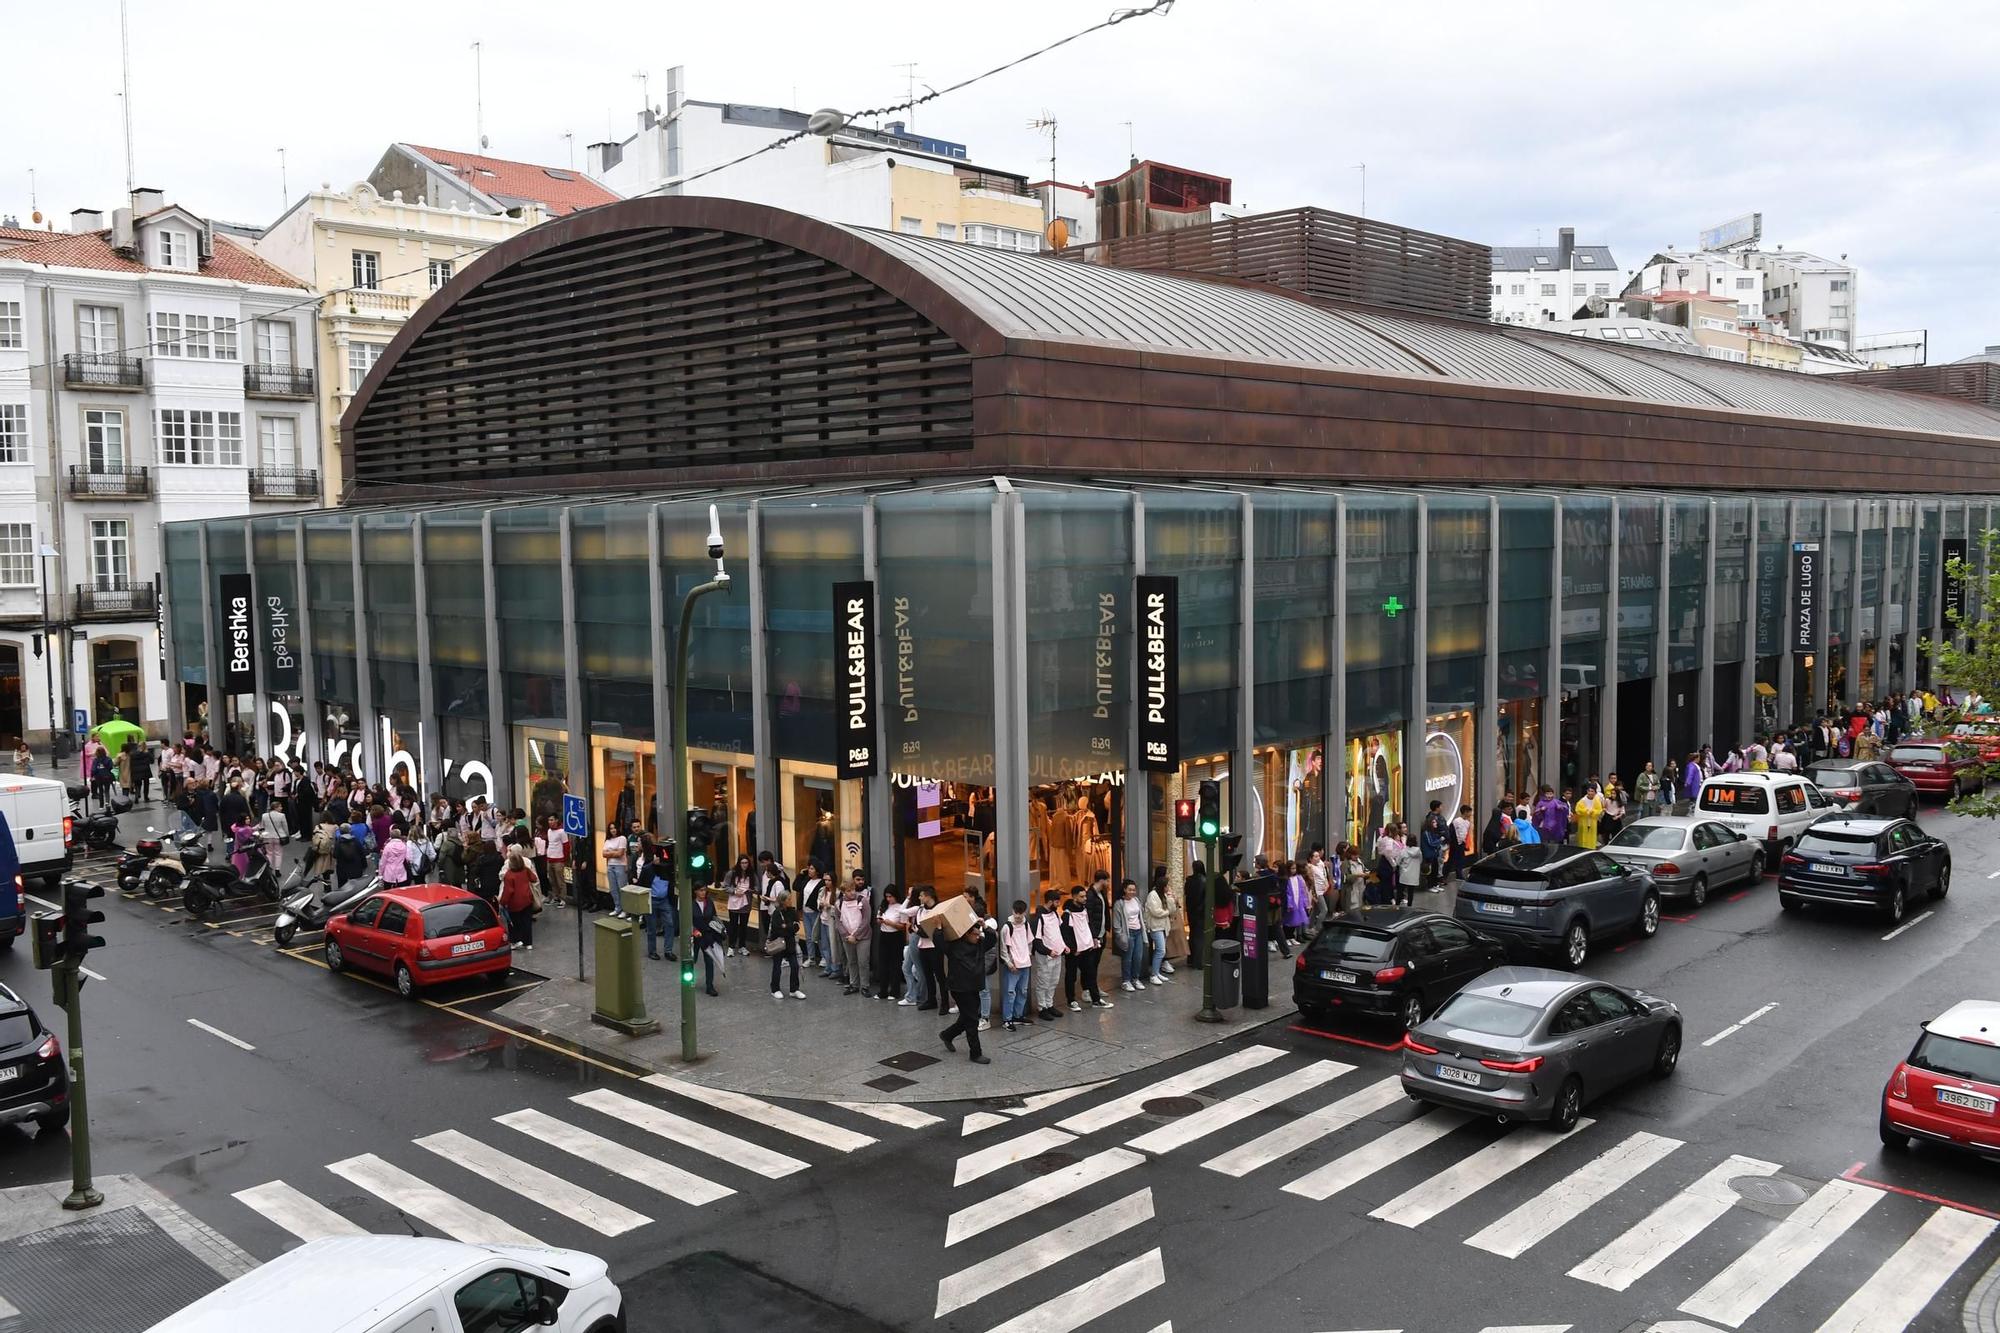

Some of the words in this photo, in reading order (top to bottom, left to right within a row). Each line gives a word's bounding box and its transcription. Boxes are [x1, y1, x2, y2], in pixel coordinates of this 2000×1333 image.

[1802, 555, 1813, 588] LUGO
[1801, 590, 1812, 609] DE
[228, 596, 250, 672] Bershka
[1800, 610, 1812, 646] PRAZA
[847, 598, 867, 729] PULL&BEAR
[1148, 593, 1165, 723] PULL&BEAR
[849, 747, 869, 761] P&B
[1147, 741, 1168, 755] P&B
[1708, 788, 1735, 803] IJM
[1442, 1067, 1460, 1078] 3028
[1463, 1073, 1478, 1083] MJZ
[1944, 1093, 1969, 1106] 3962
[1972, 1099, 1992, 1110] DST
